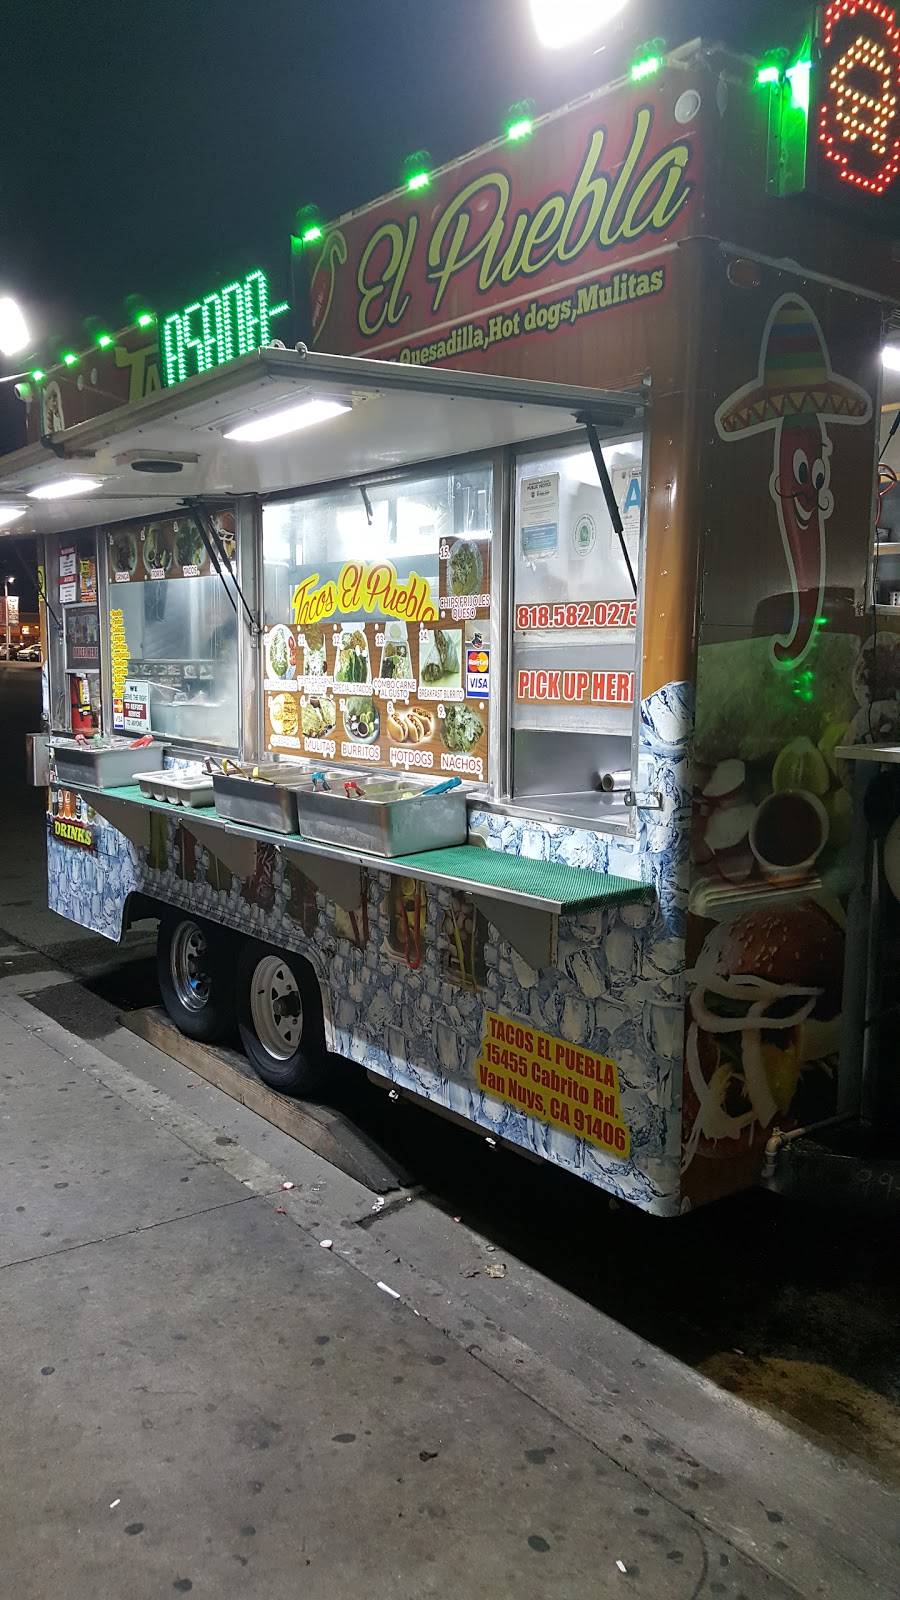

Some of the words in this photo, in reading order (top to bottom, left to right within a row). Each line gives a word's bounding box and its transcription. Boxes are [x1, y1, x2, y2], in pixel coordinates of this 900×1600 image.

[357, 216, 418, 335] El
[427, 109, 690, 311] Puebla
[623, 478, 641, 513] A
[294, 579, 336, 624] Tacos
[342, 564, 363, 609] El
[367, 564, 435, 621] Puebla
[453, 608, 476, 620] QUESO
[374, 679, 395, 689] COMBO
[396, 680, 416, 691] CARNE
[470, 678, 488, 688] VISA
[519, 672, 560, 697] PICK
[564, 673, 588, 699] UP
[380, 689, 388, 697] AL
[389, 689, 408, 698] GUSTO
[304, 738, 335, 753] MULITAS
[342, 744, 380, 760] BURRITOS
[391, 749, 432, 765] HOTDOGS
[441, 756, 482, 772] NACHOS
[55, 821, 92, 845] DRINKS
[489, 1018, 534, 1052] TACOS
[537, 1037, 552, 1062] EL
[556, 1043, 615, 1088] PUEBLA
[485, 1043, 528, 1077] 15455
[532, 1061, 589, 1106] Cabrito
[593, 1091, 619, 1119] Rd.
[480, 1064, 505, 1094] Van
[508, 1079, 546, 1116] Nuys,
[550, 1098, 570, 1125] CA
[574, 1109, 626, 1151] 91406
